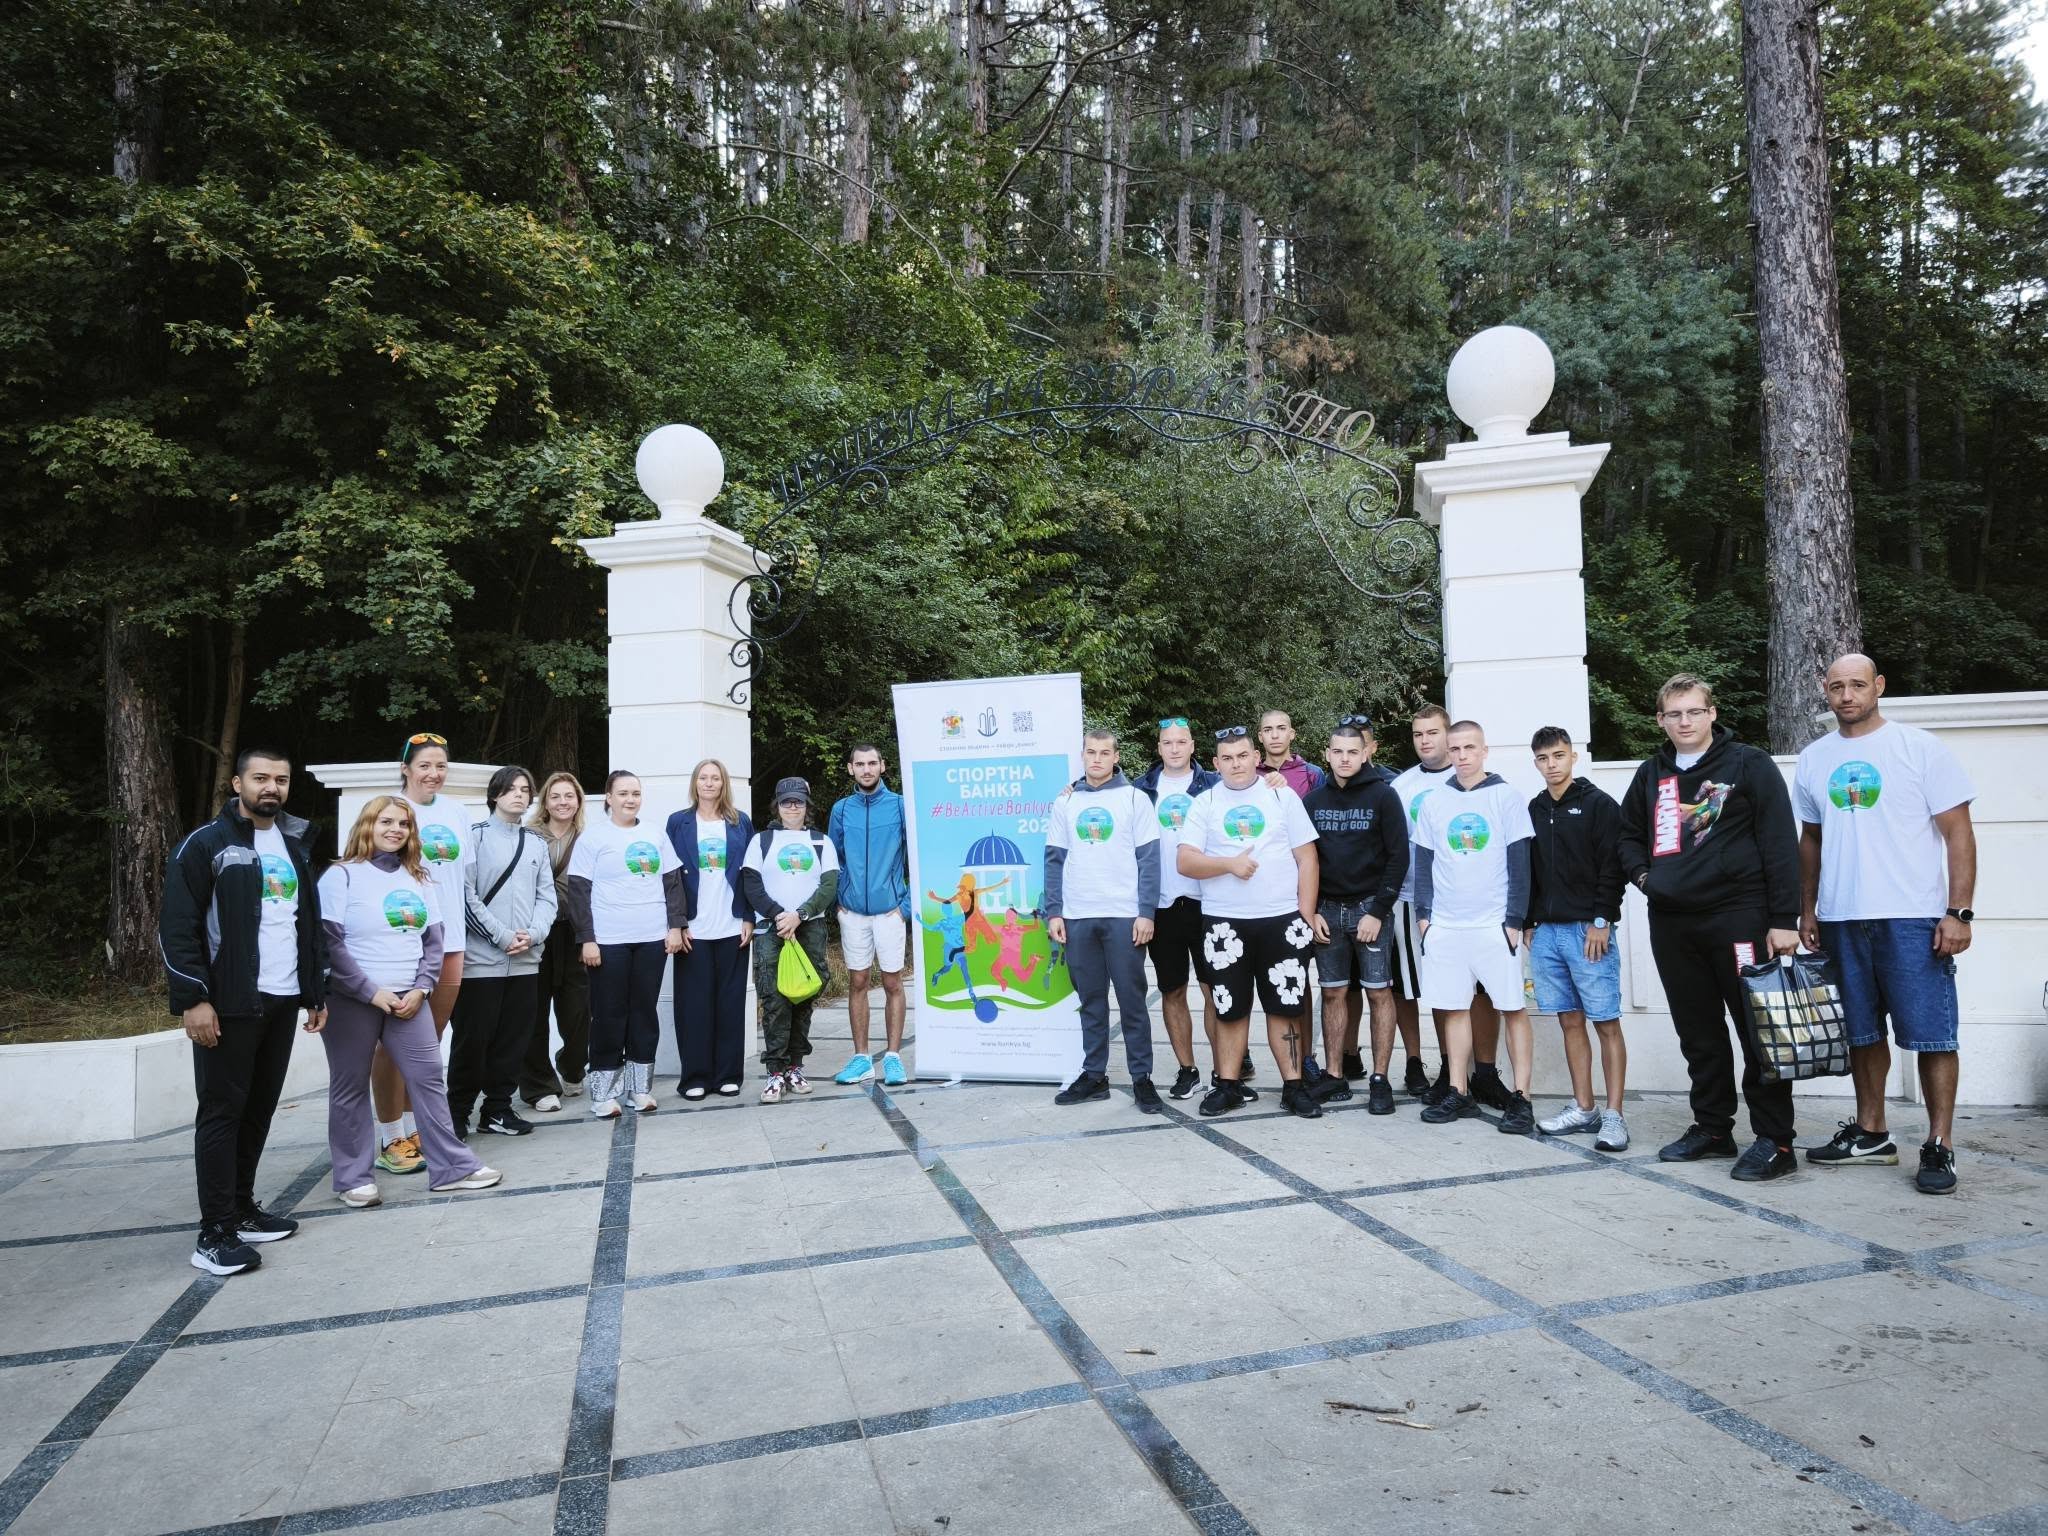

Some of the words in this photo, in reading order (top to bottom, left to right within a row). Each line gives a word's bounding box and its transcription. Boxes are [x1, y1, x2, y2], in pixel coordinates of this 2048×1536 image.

[946, 765, 1034, 783] СПОРТНА
[960, 782, 1022, 799] БАНКЯ
[1314, 809, 1374, 821] ESSENTIALS
[1655, 779, 1679, 852] MARVEL
[1317, 821, 1338, 831] FEAR
[1350, 820, 1370, 830] GOD
